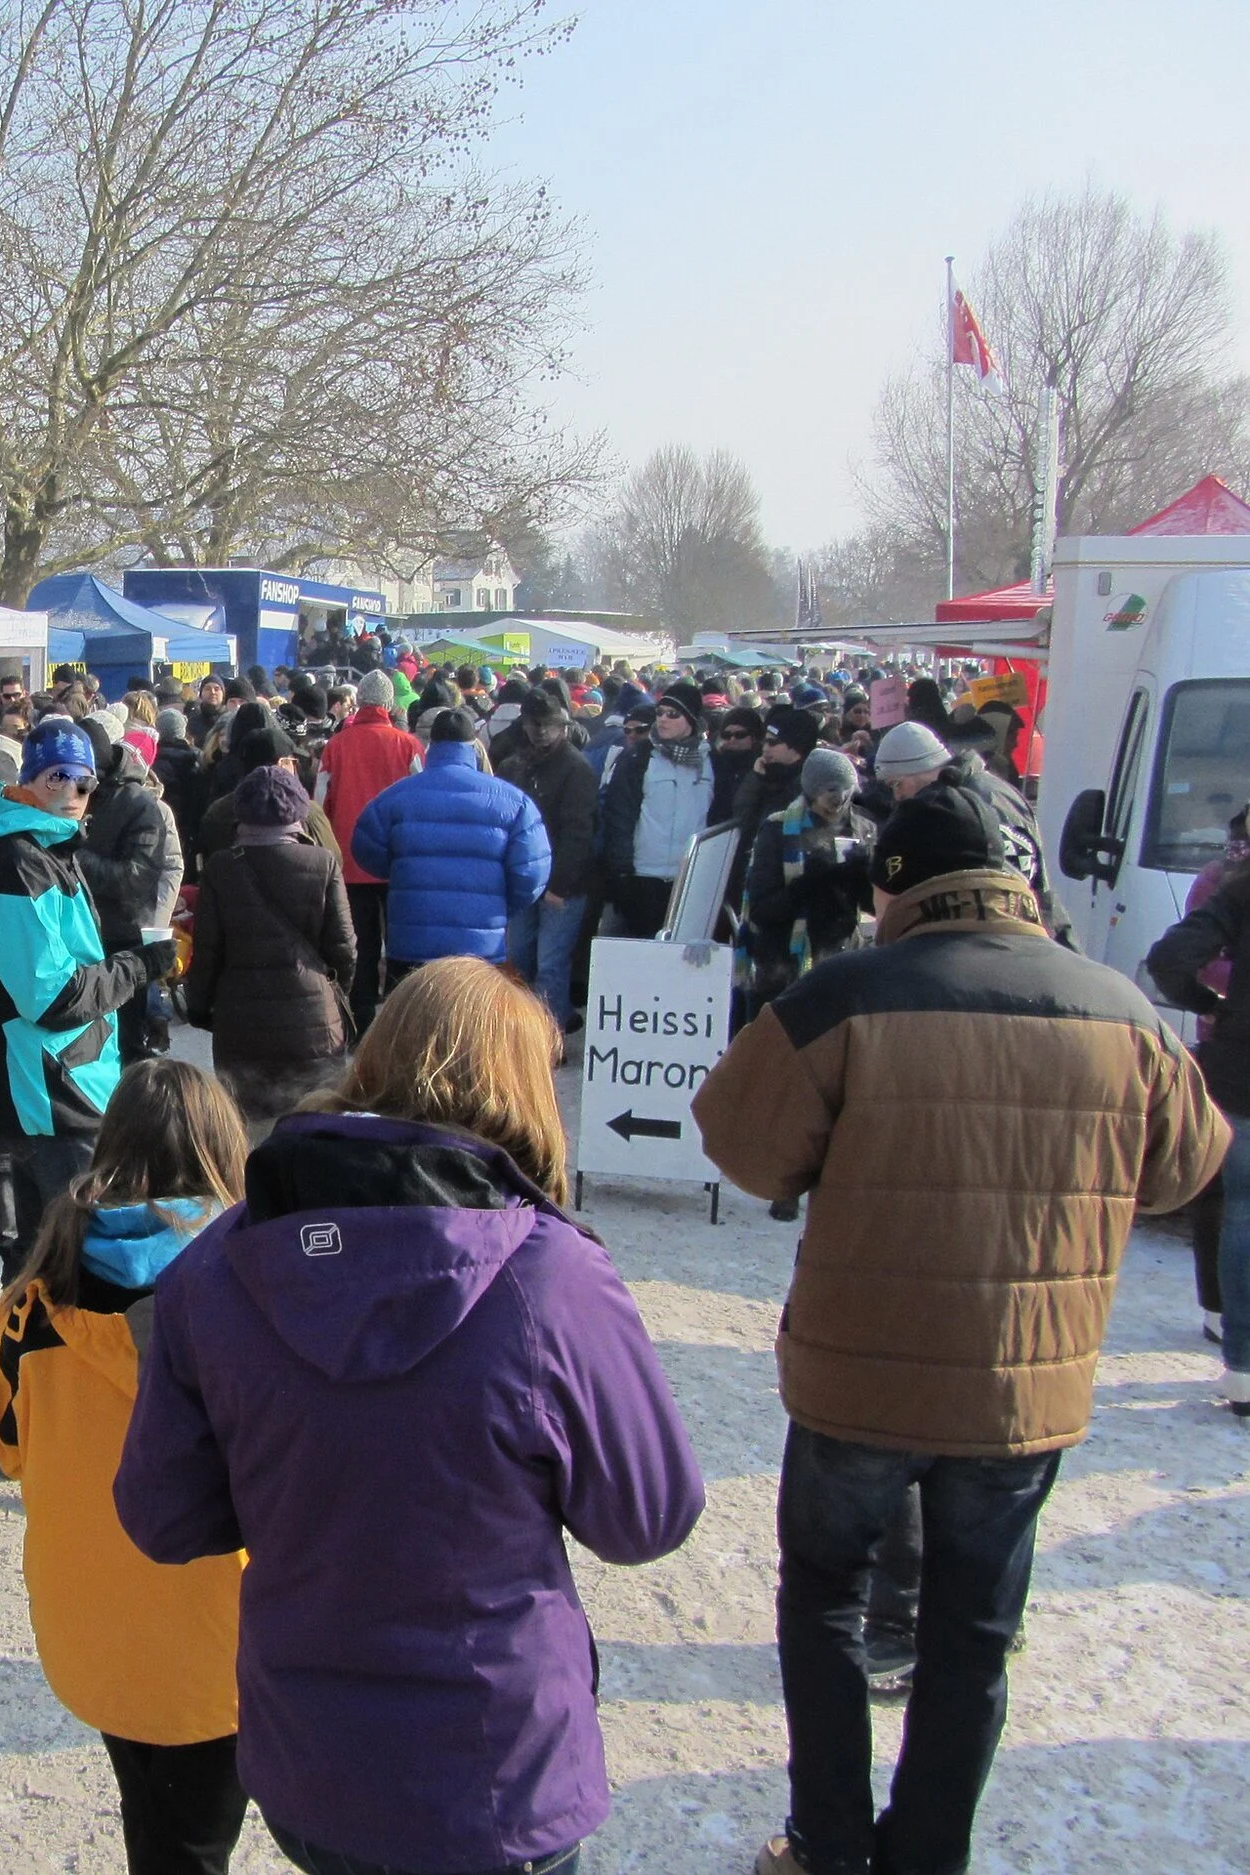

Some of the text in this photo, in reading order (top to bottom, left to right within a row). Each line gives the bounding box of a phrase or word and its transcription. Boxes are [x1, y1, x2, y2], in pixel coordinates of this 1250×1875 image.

[261, 580, 299, 605] FANSHOP
[886, 856, 902, 882] B
[599, 994, 713, 1037] Heissi
[587, 1045, 724, 1090] Maron
